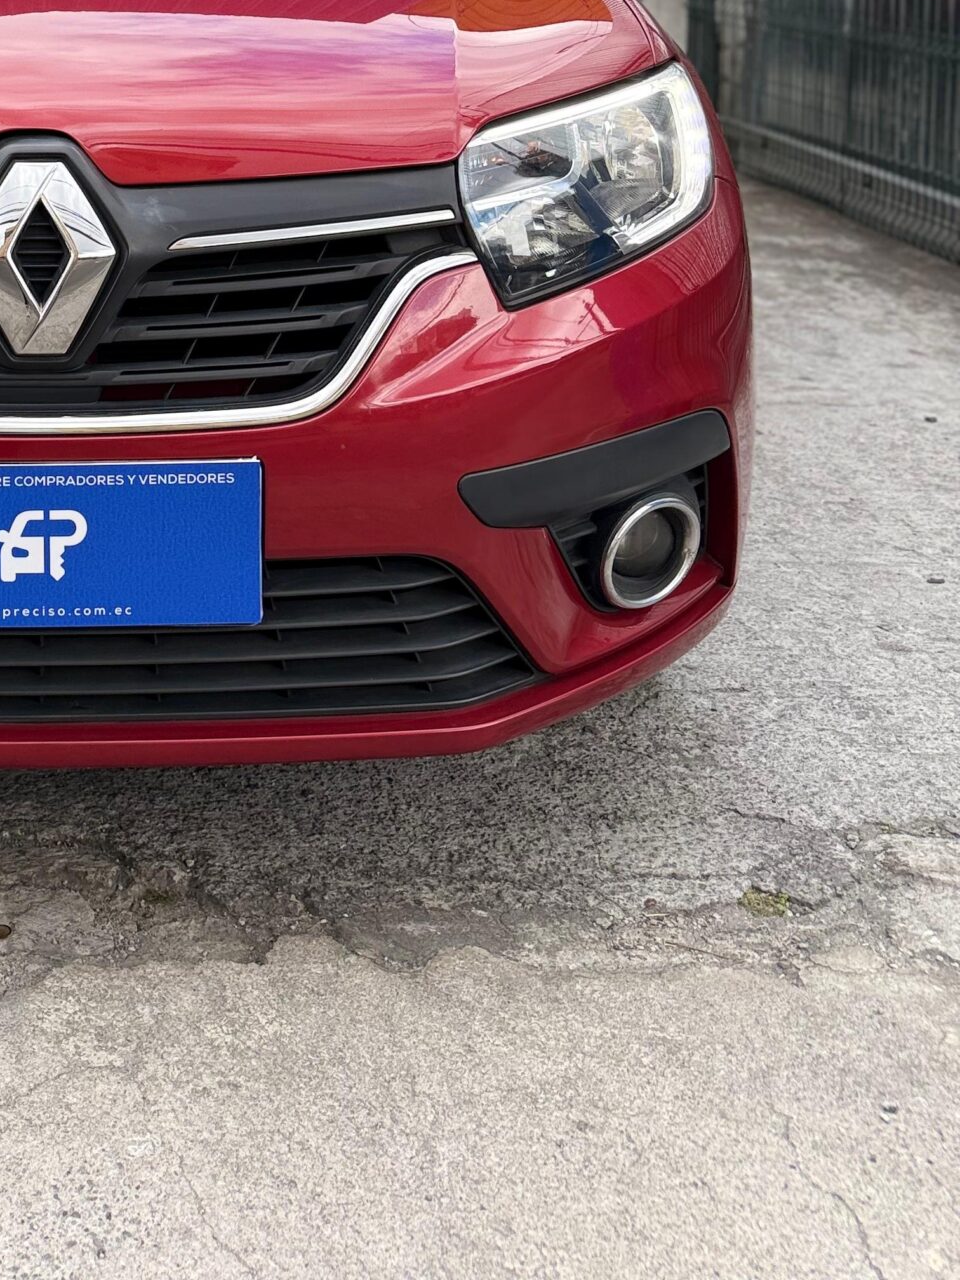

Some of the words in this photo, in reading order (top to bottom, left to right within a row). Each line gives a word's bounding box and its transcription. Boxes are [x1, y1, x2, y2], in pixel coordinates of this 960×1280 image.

[14, 474, 125, 487] COMPRADORES
[127, 474, 137, 485] Y
[139, 472, 236, 485] VENDEDORES
